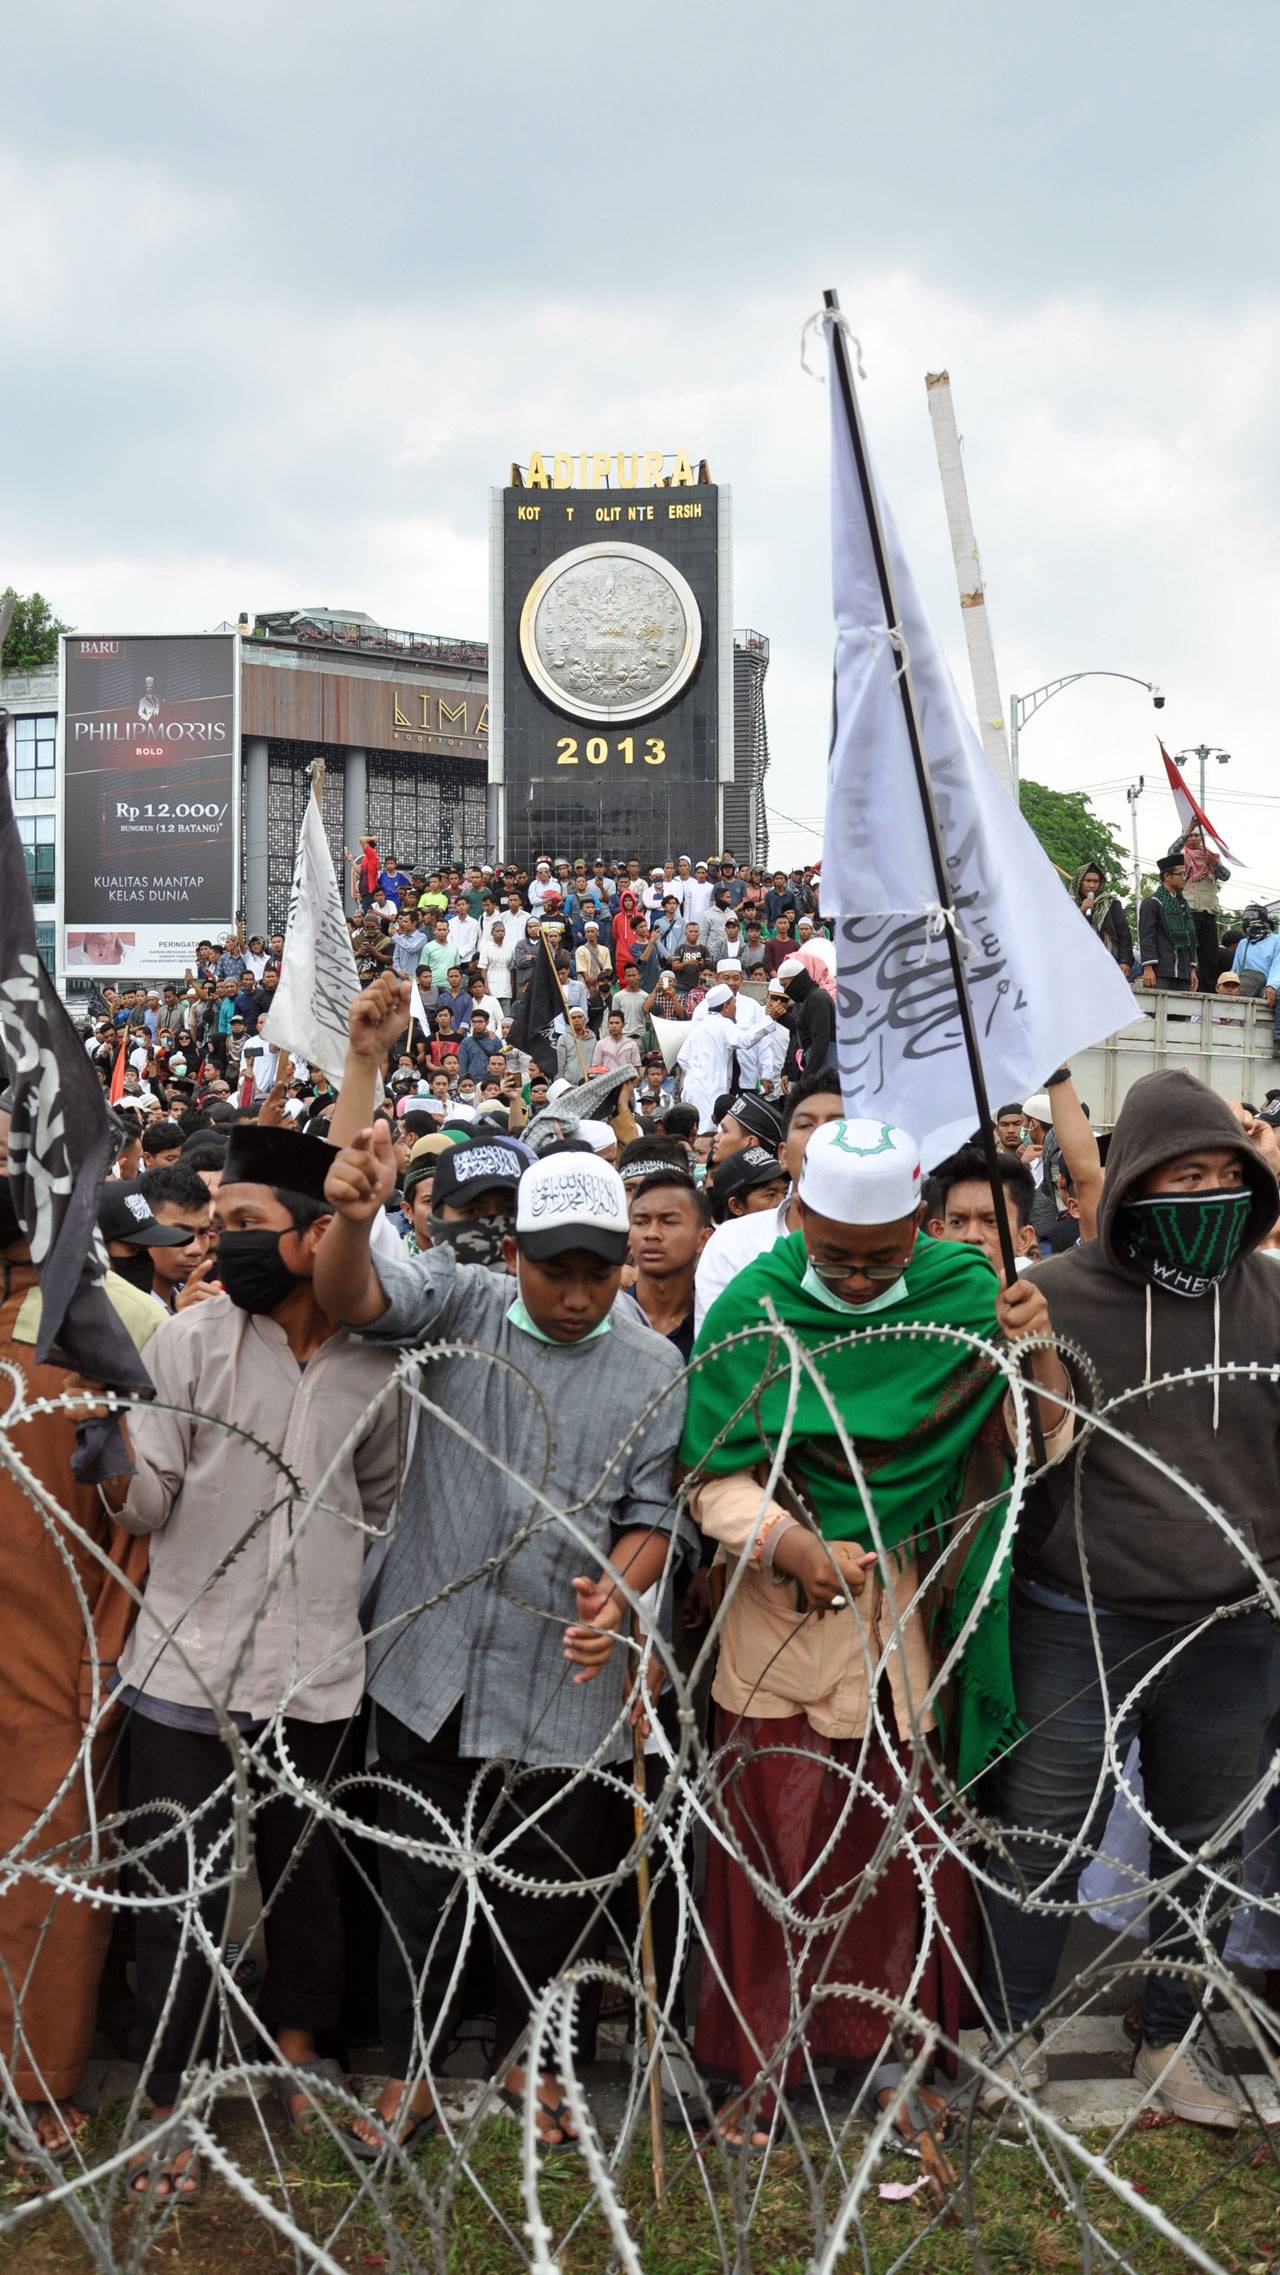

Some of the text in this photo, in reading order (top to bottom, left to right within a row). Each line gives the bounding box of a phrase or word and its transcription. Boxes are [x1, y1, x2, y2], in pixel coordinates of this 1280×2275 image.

[525, 450, 695, 489] ADIPURA
[80, 641, 119, 653] BARU
[135, 748, 164, 756] BOLD
[556, 737, 666, 765] 2013
[116, 802, 140, 822] Rp
[156, 823, 175, 833] (12
[94, 876, 205, 888] KUALITAS MANTAP
[108, 890, 189, 901] KELAS DUNIA
